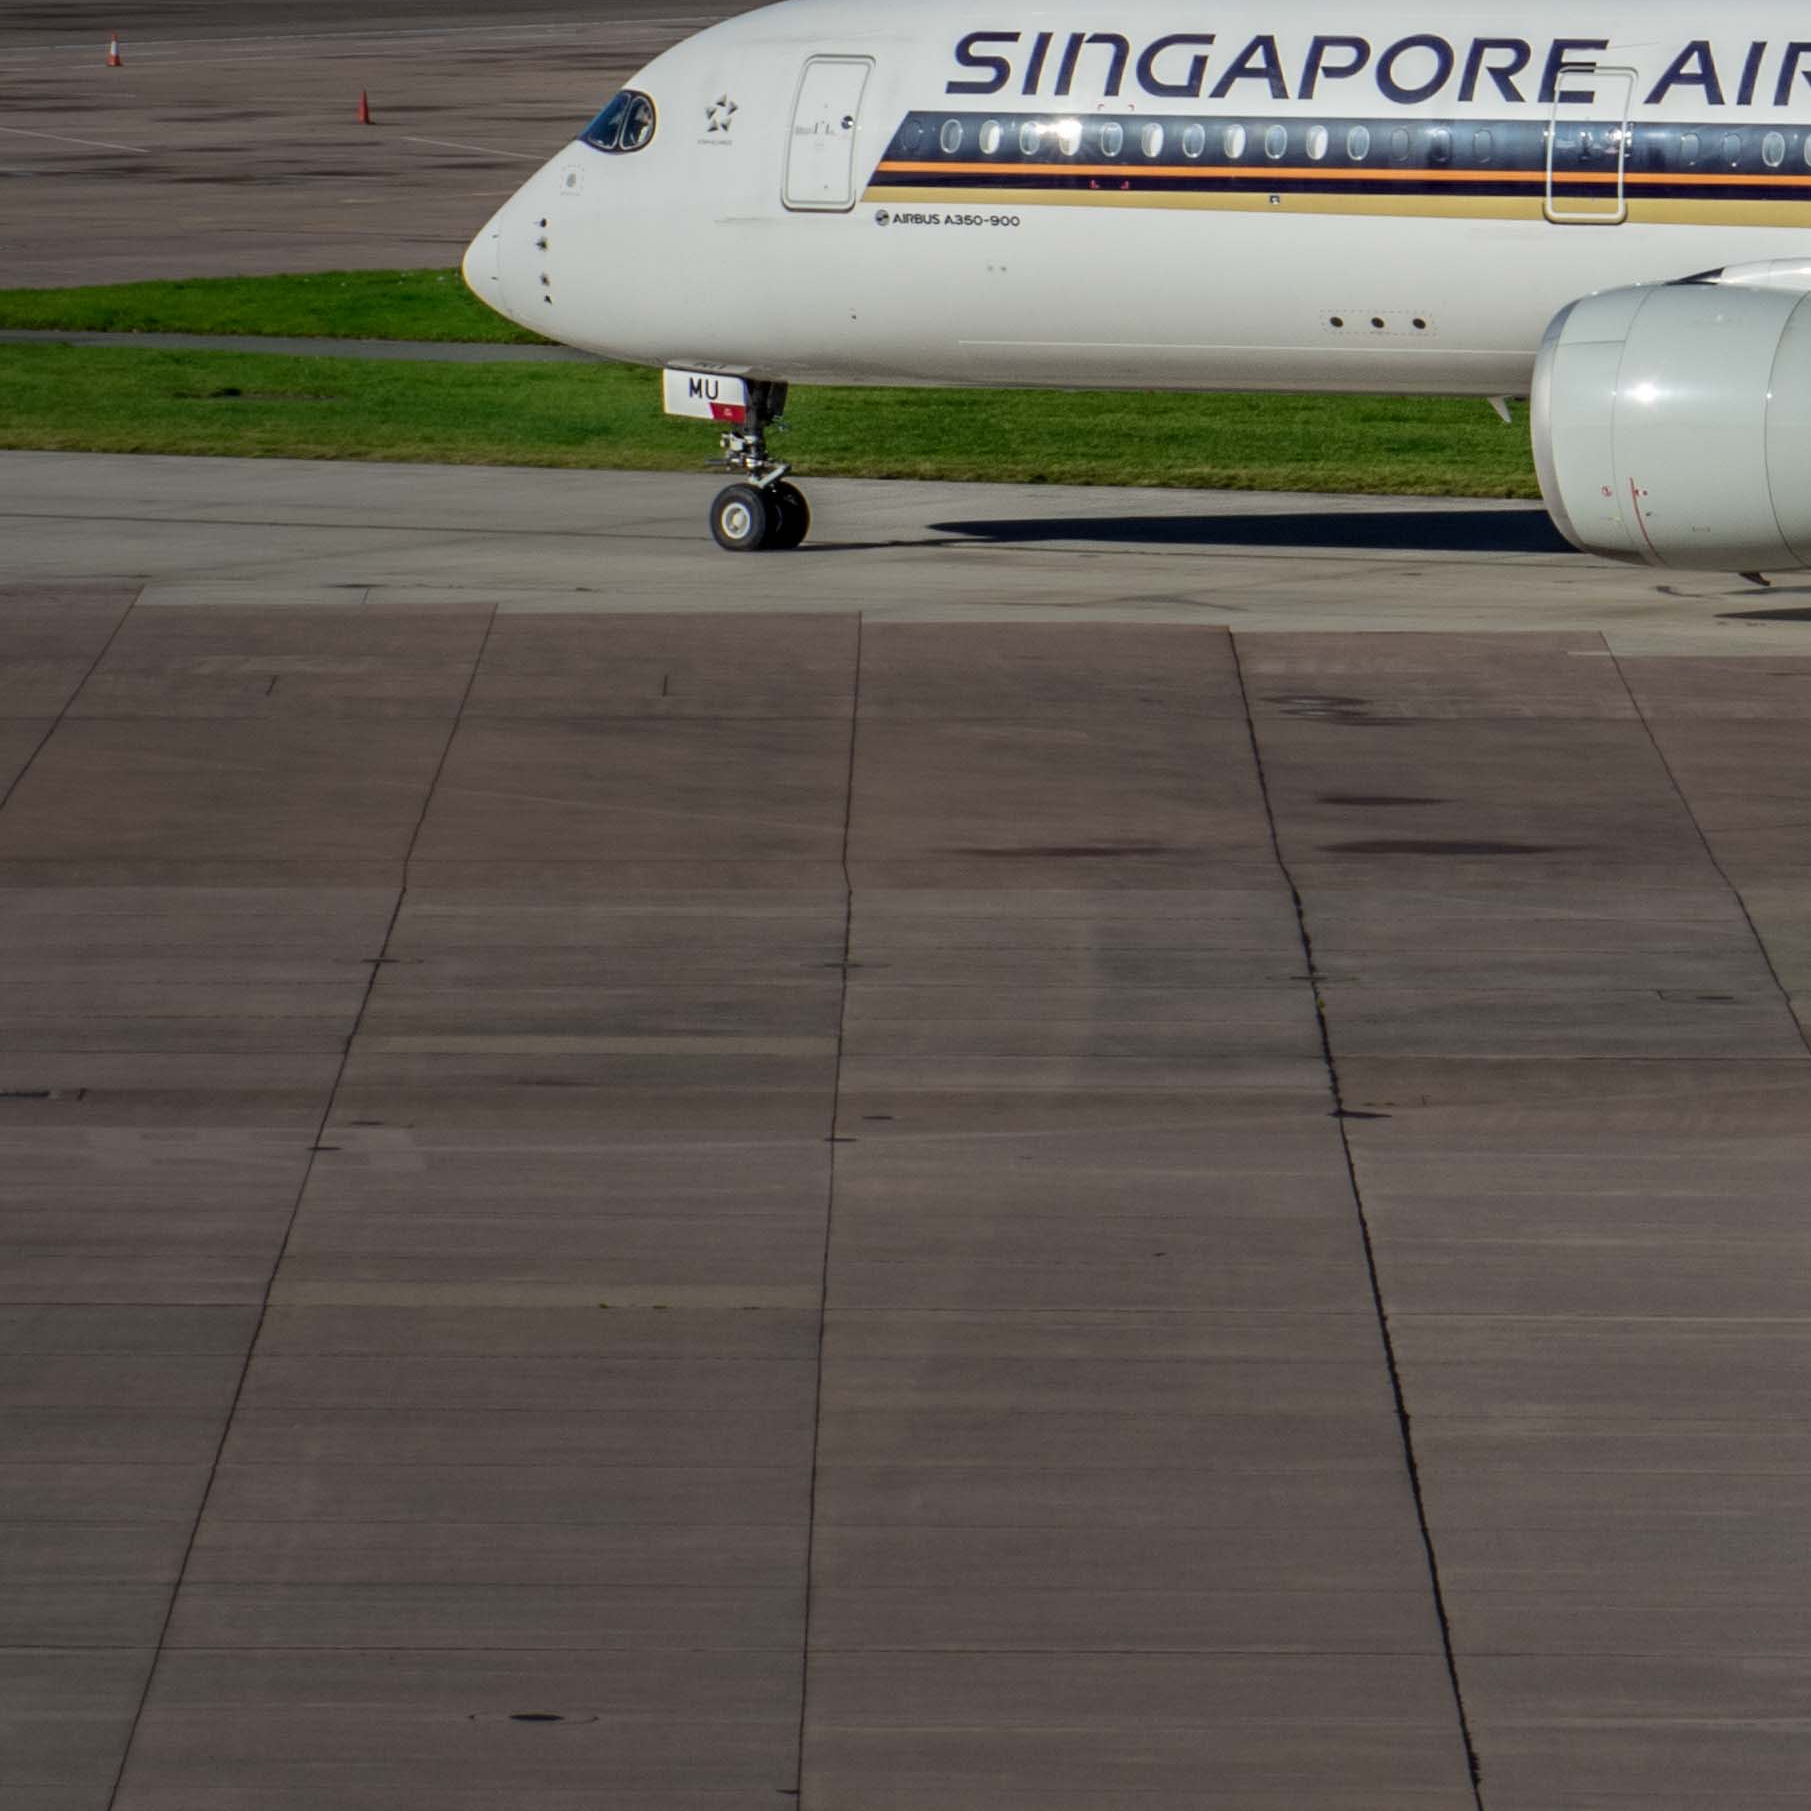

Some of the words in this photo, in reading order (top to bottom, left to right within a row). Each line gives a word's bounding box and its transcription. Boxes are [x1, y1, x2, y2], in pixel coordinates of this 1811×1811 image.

[945, 30, 1610, 105] SINGAPORE
[892, 211, 941, 226] AIRBUS
[944, 214, 1021, 228] A350-900
[688, 376, 719, 400] MU
